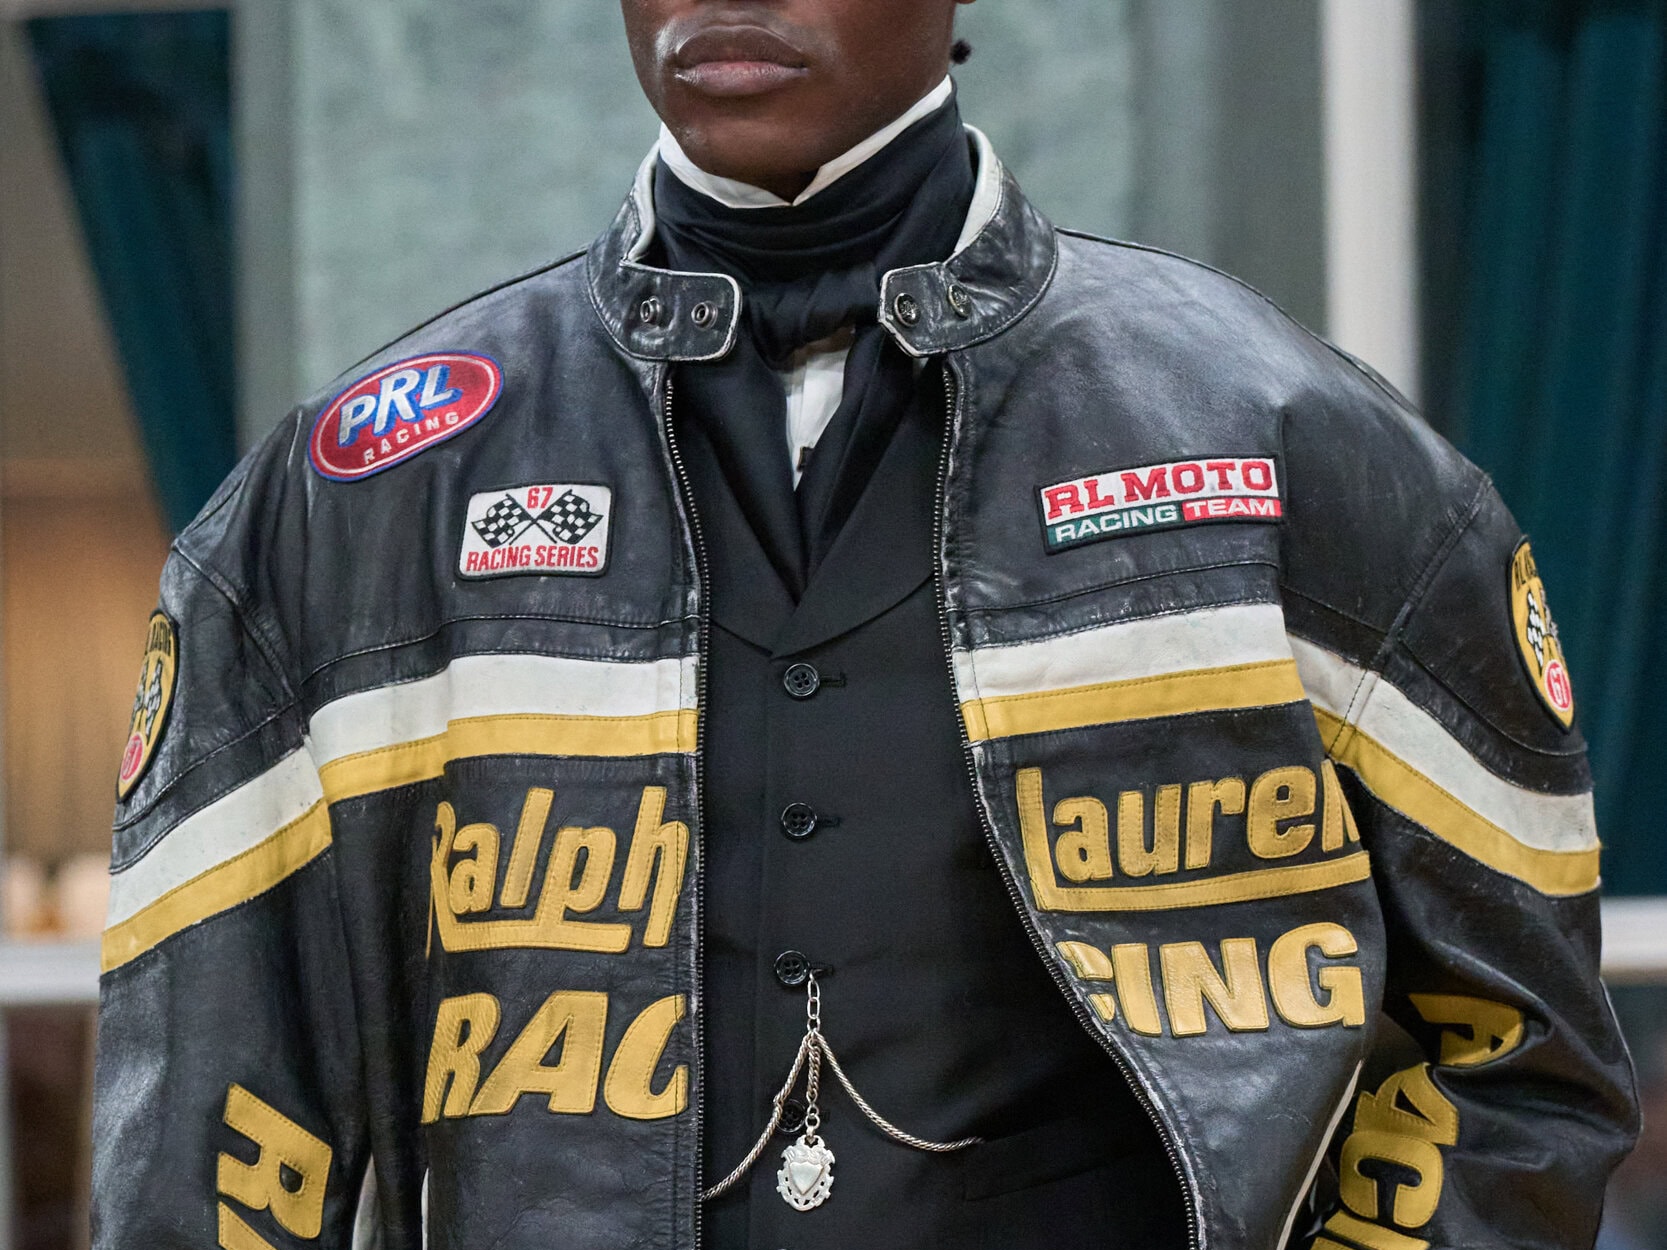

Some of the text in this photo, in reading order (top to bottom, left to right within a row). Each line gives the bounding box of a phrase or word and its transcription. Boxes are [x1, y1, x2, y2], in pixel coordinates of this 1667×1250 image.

[338, 364, 459, 447] PRL
[363, 410, 459, 465] RACING
[527, 487, 553, 509] 67
[1044, 461, 1273, 519] RL MOTO
[1055, 499, 1275, 543] RACING TEAM
[466, 545, 598, 572] RACING SERIES
